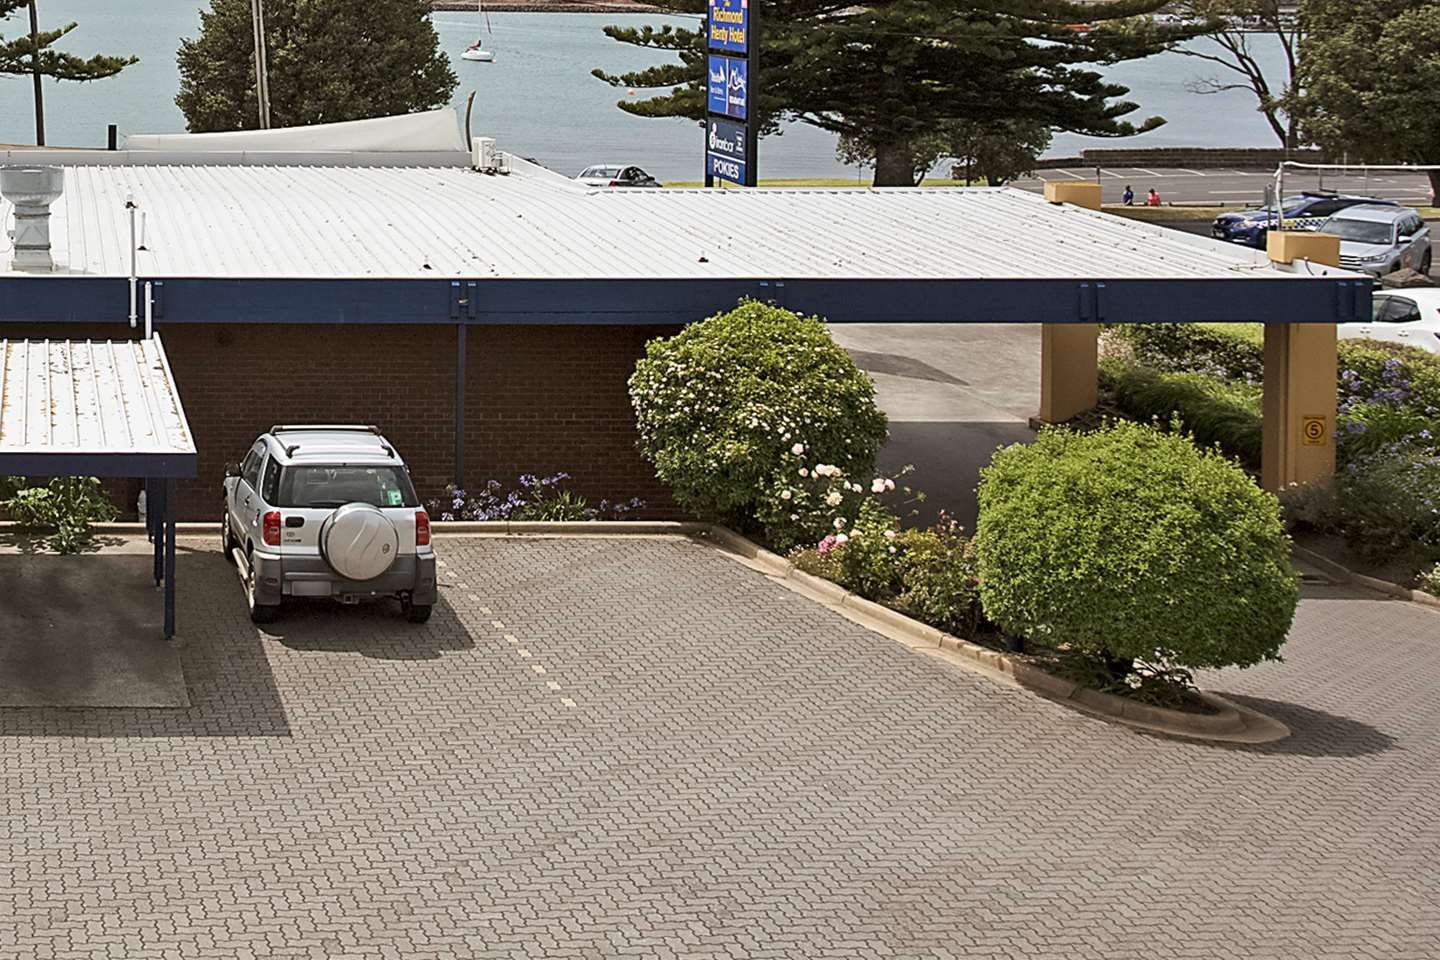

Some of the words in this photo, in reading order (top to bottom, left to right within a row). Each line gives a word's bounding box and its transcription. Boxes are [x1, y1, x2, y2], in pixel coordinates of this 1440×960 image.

[713, 7, 743, 24] Richmond
[711, 24, 729, 45] Henty
[729, 26, 745, 44] Hotel
[713, 158, 739, 179] POKIES
[1310, 424, 1319, 436] 5
